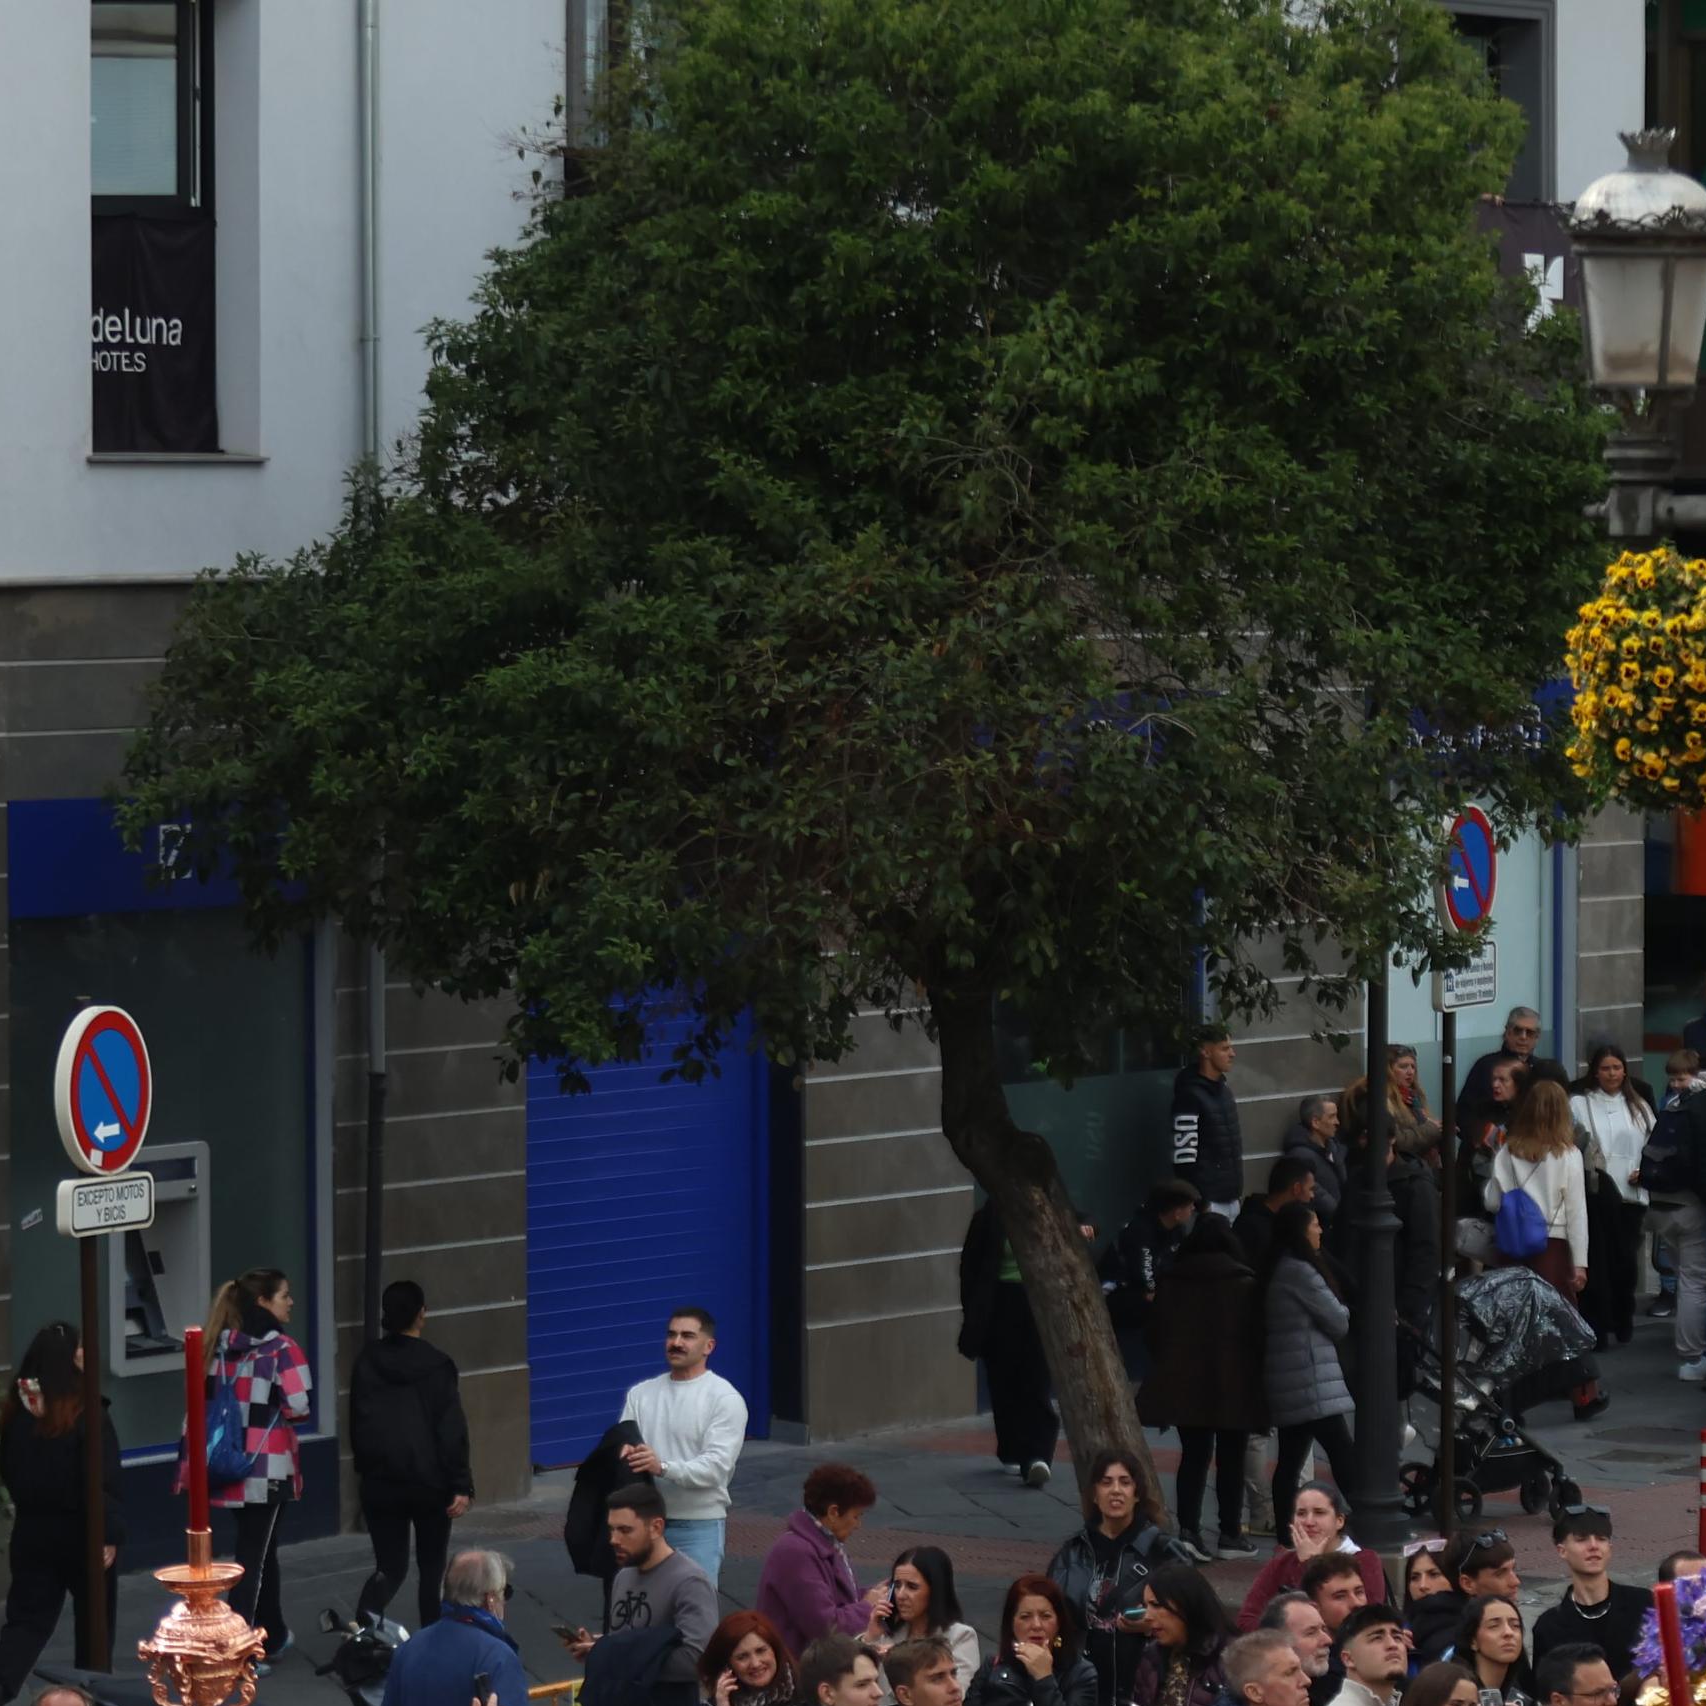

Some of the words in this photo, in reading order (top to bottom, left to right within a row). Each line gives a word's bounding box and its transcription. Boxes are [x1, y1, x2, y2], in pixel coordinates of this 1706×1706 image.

[91, 306, 183, 346] deLuna
[77, 1187, 114, 1207] EXCEPTO
[116, 1182, 145, 1201] MOTOS
[96, 1209, 103, 1223] Y
[104, 1205, 126, 1222] BICIS
